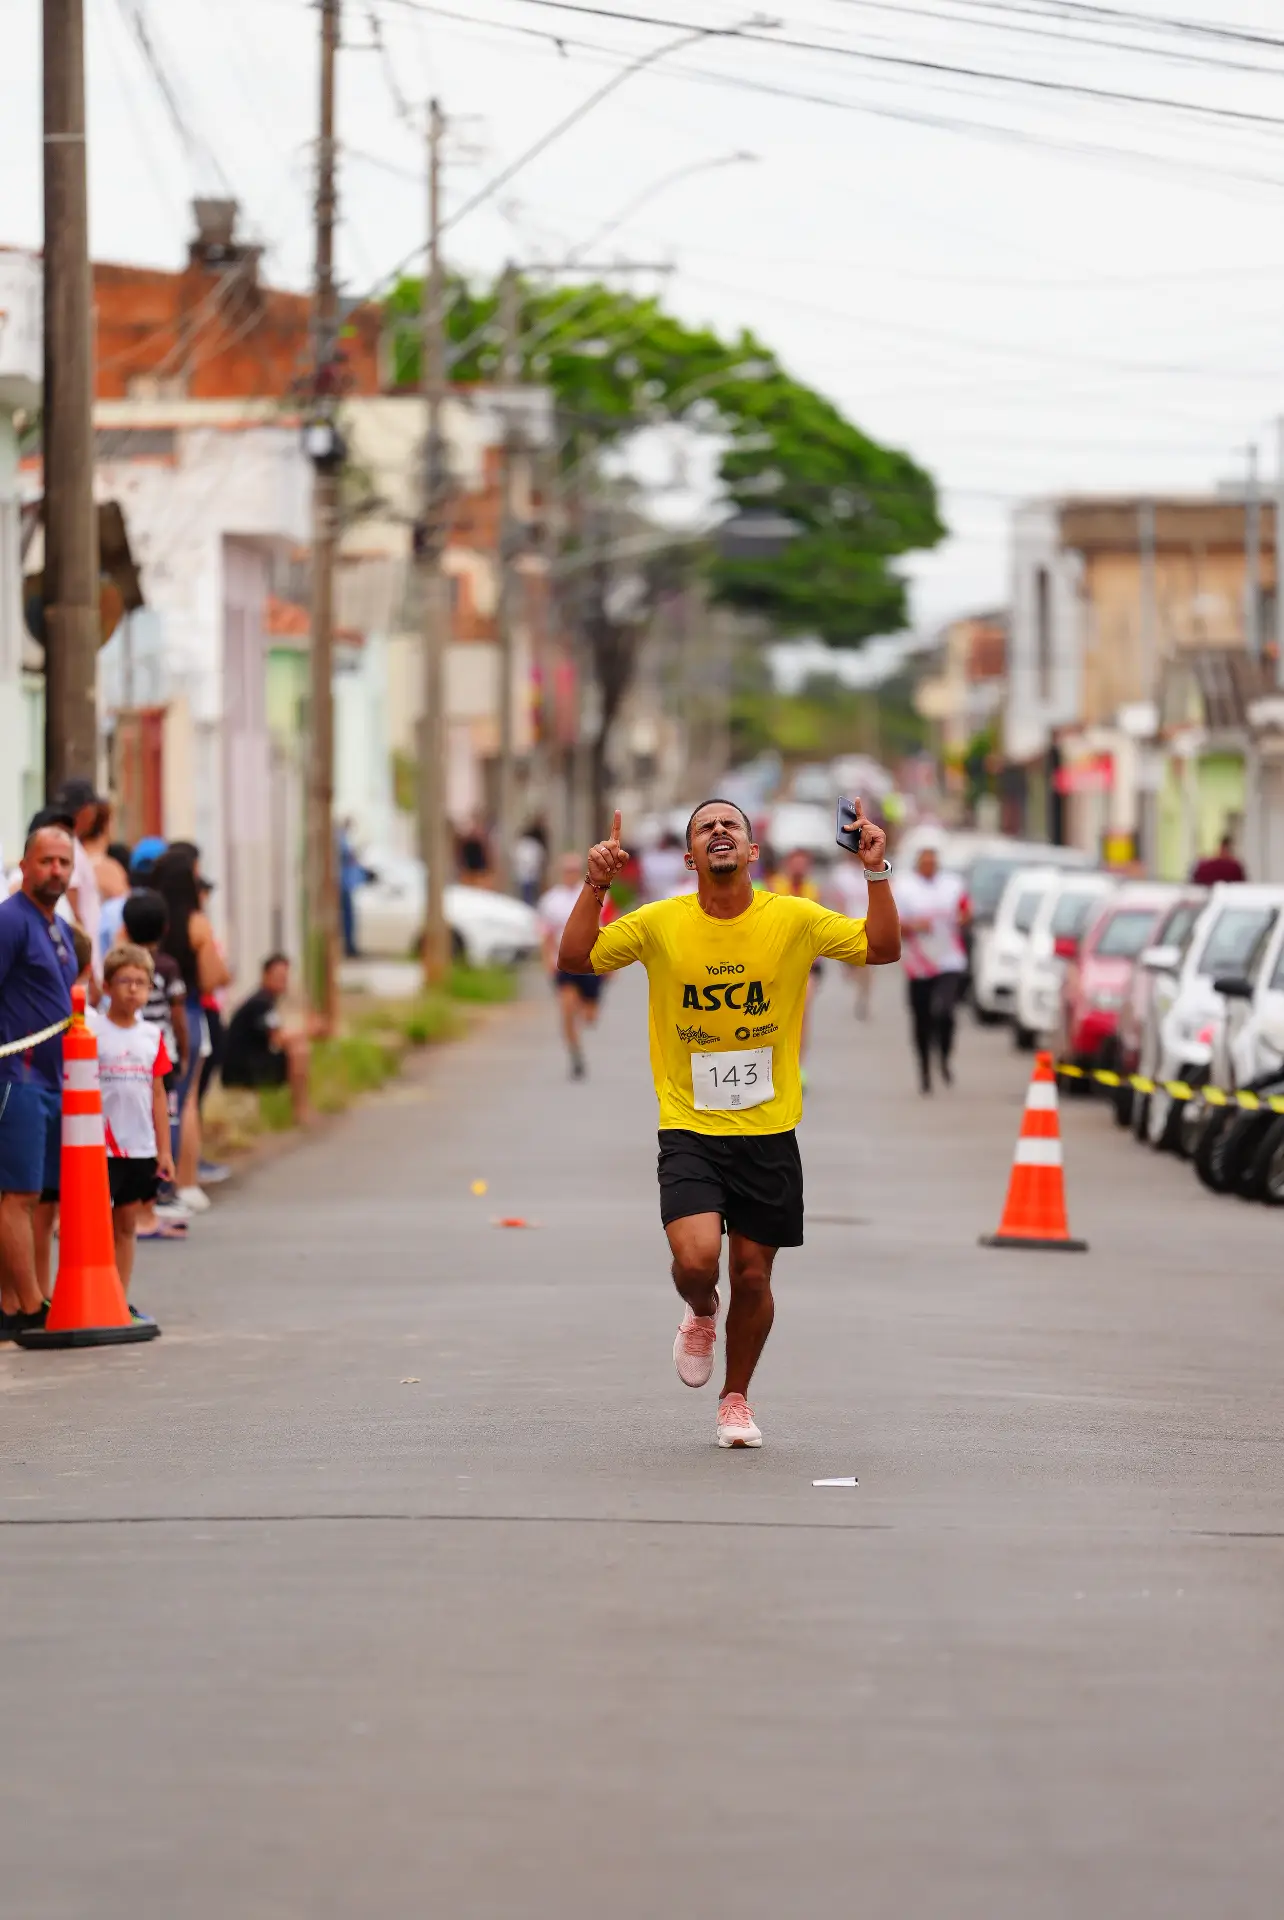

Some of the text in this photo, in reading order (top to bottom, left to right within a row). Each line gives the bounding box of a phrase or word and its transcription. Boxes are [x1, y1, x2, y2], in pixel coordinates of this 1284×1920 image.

[683, 981, 764, 1011] ASCA
[743, 998, 771, 1016] RUN
[709, 1063, 758, 1087] 143
